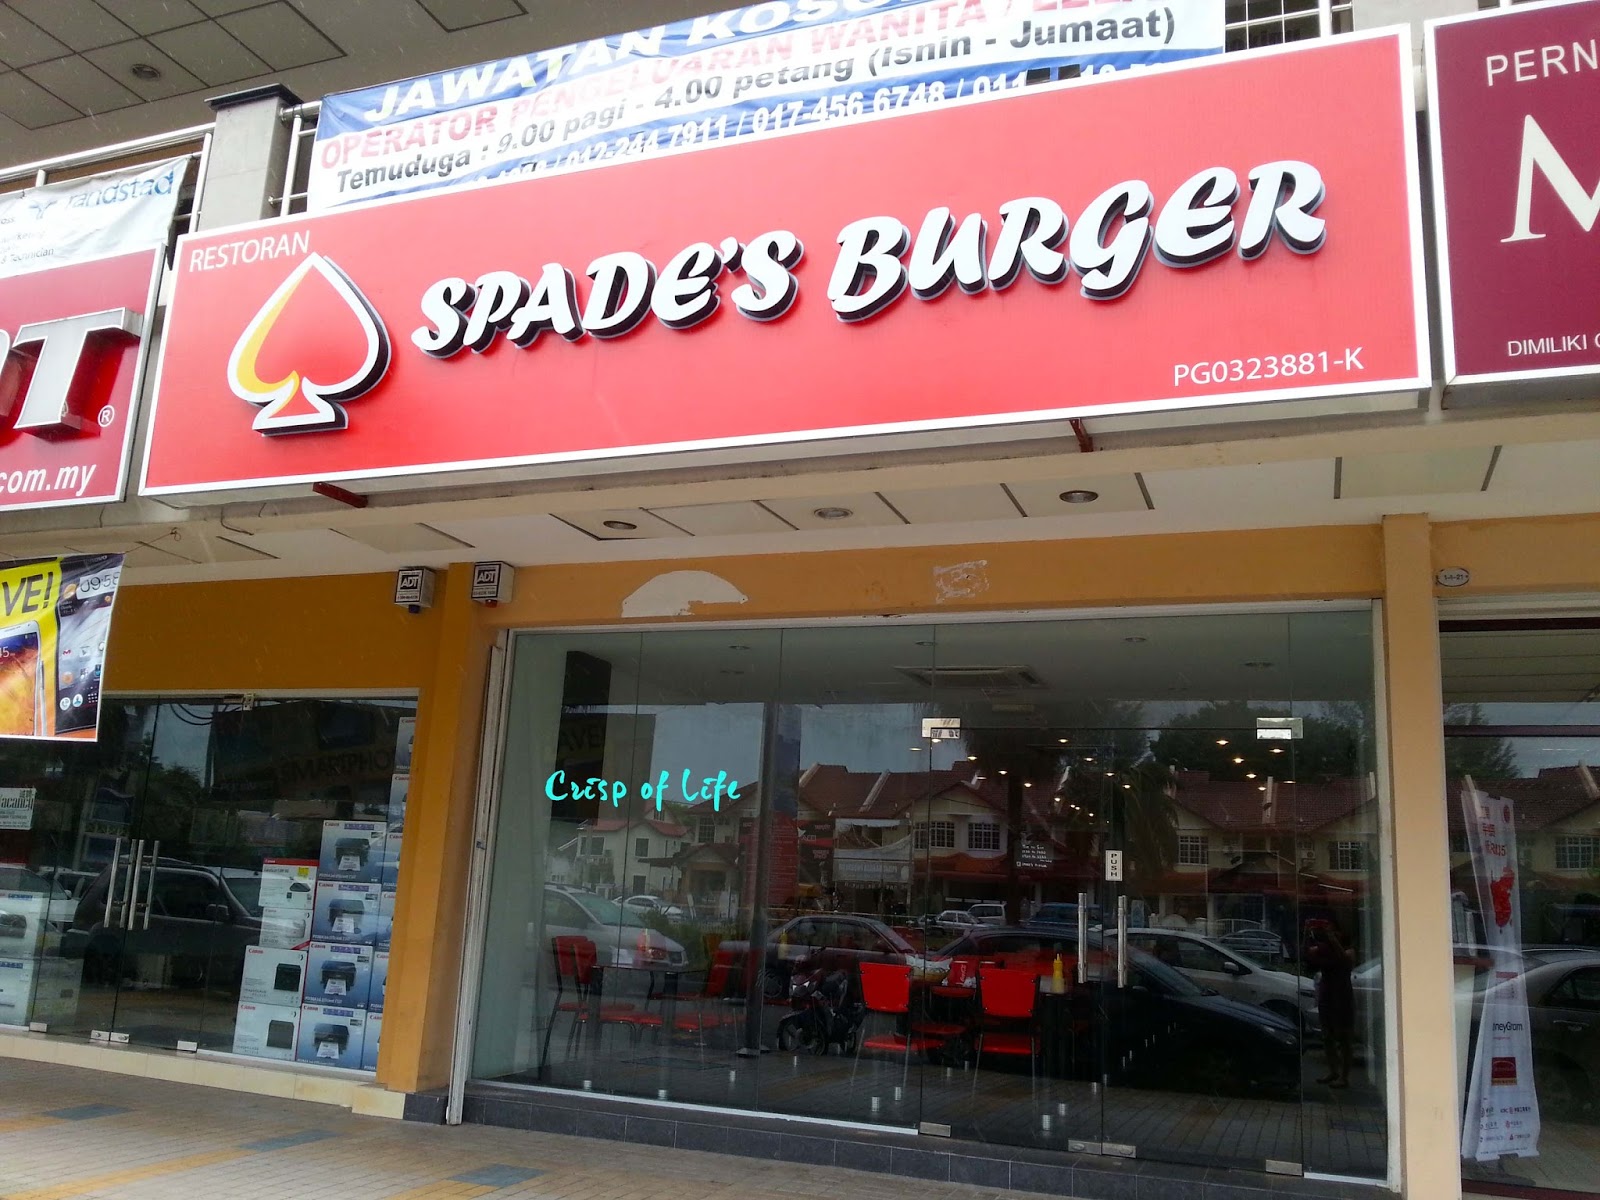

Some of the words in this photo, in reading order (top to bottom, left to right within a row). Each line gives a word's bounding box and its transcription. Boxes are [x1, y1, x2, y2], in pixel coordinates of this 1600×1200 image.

[321, 105, 497, 169] OPERATOR
[811, 0, 987, 53] WANITA
[363, 25, 662, 122] JAWATAN
[337, 149, 471, 192] Temuduga
[497, 120, 555, 155] 9.00
[563, 99, 627, 141] pagi
[654, 76, 723, 109] 4.00
[733, 57, 854, 98] petang
[1010, 7, 1175, 48] Jumaat)
[873, 81, 945, 115] 6748
[65, 170, 174, 208] randstad
[189, 230, 310, 272] RESTORAN
[411, 230, 804, 358] SPADE'S
[827, 160, 1326, 323] BURGER
[1507, 334, 1587, 357] DIMILIKI
[1174, 346, 1364, 387] PG0323881-K
[401, 577, 418, 588] ADT
[477, 571, 496, 582] ADT
[1110, 853, 1118, 877] PUSH
